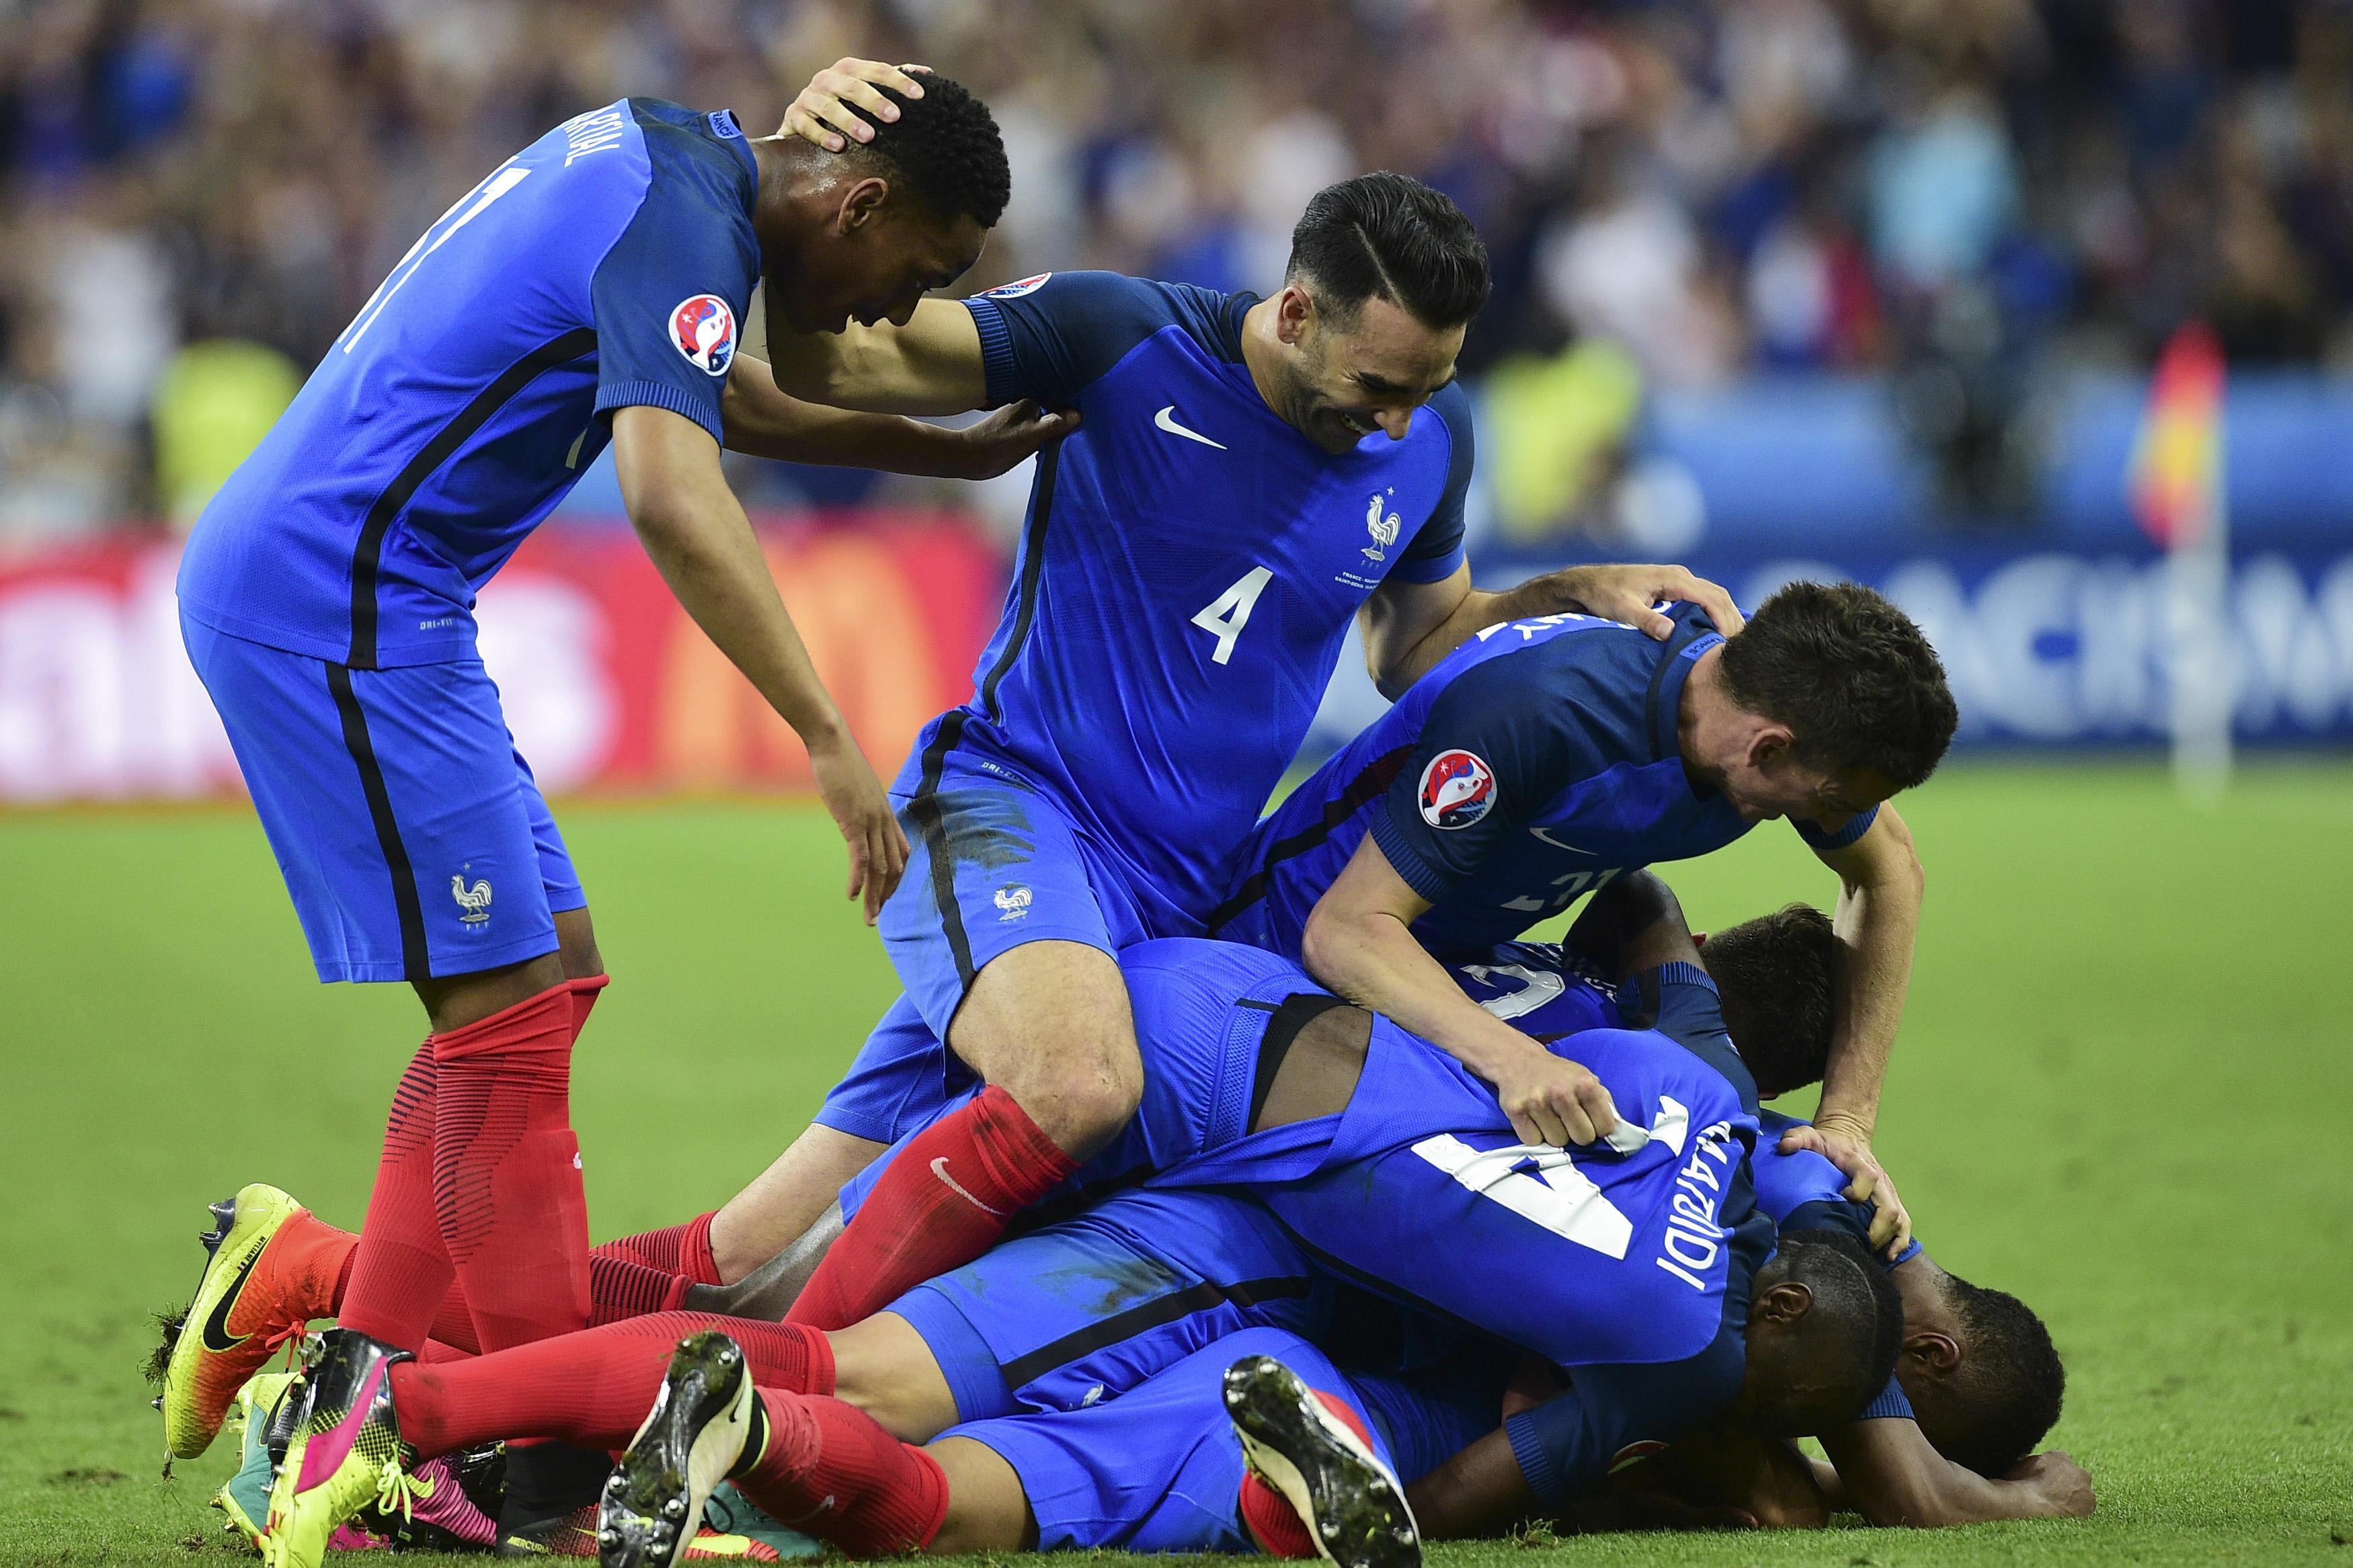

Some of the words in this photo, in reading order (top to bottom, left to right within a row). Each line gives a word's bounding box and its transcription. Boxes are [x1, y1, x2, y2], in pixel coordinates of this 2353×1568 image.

[563, 105, 623, 167] ARTIAL
[712, 111, 733, 136] RANCE
[1190, 566, 1273, 665] 4
